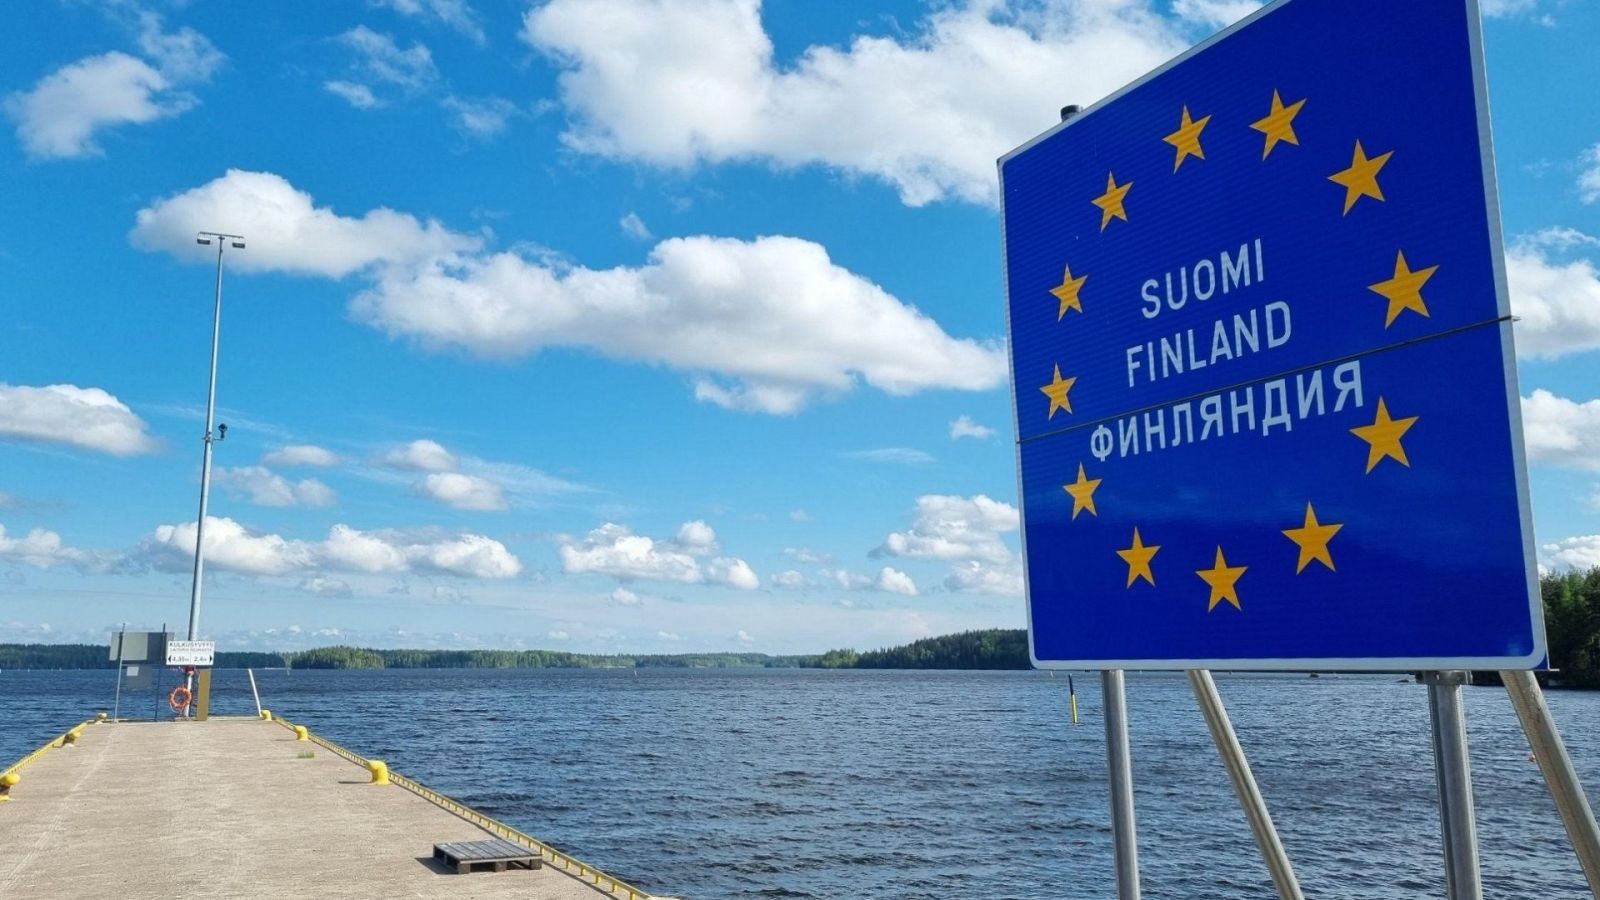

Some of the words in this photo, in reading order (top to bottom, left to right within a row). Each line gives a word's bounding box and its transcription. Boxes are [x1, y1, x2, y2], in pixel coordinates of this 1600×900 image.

[1141, 238, 1264, 319] SUOMI
[1126, 301, 1291, 388] FINLAND
[1090, 360, 1363, 462] ФИНЛЯНДИЯ
